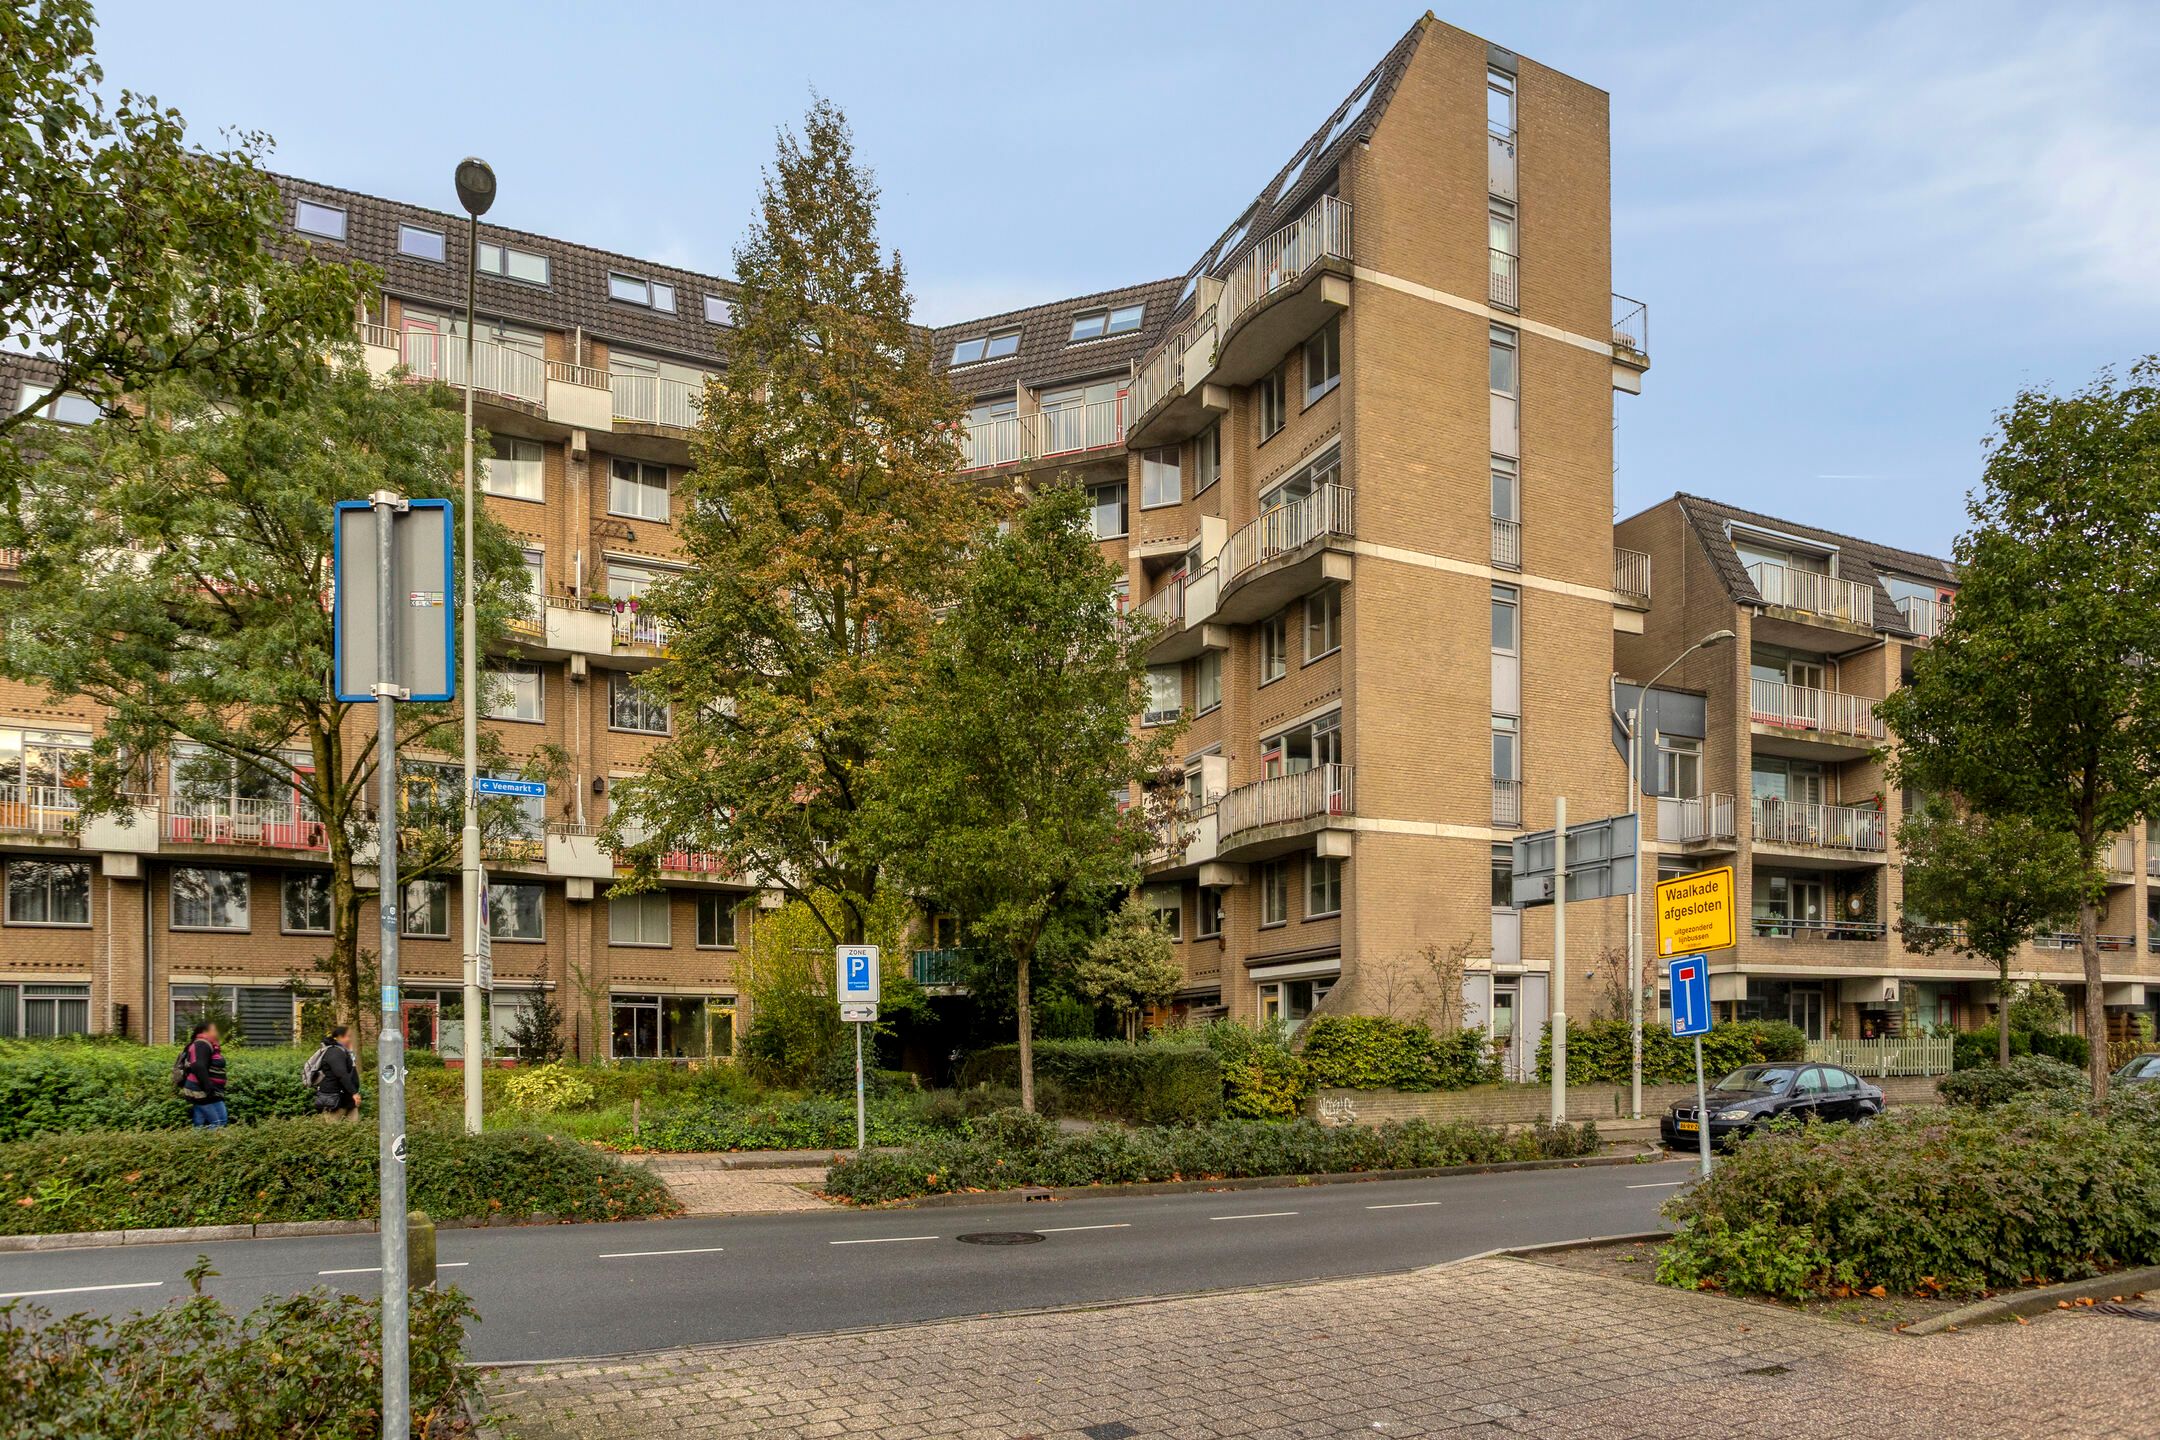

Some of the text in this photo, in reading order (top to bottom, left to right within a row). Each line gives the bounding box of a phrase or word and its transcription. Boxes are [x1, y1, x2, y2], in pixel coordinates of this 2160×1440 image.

[492, 782, 532, 793] Veemarkt
[1665, 881, 1719, 901] Waalkade
[1664, 900, 1722, 921] afgesloten
[1674, 922, 1713, 936] uitgezonderd
[1678, 933, 1710, 944] lijnbussen
[851, 958, 865, 977] P
